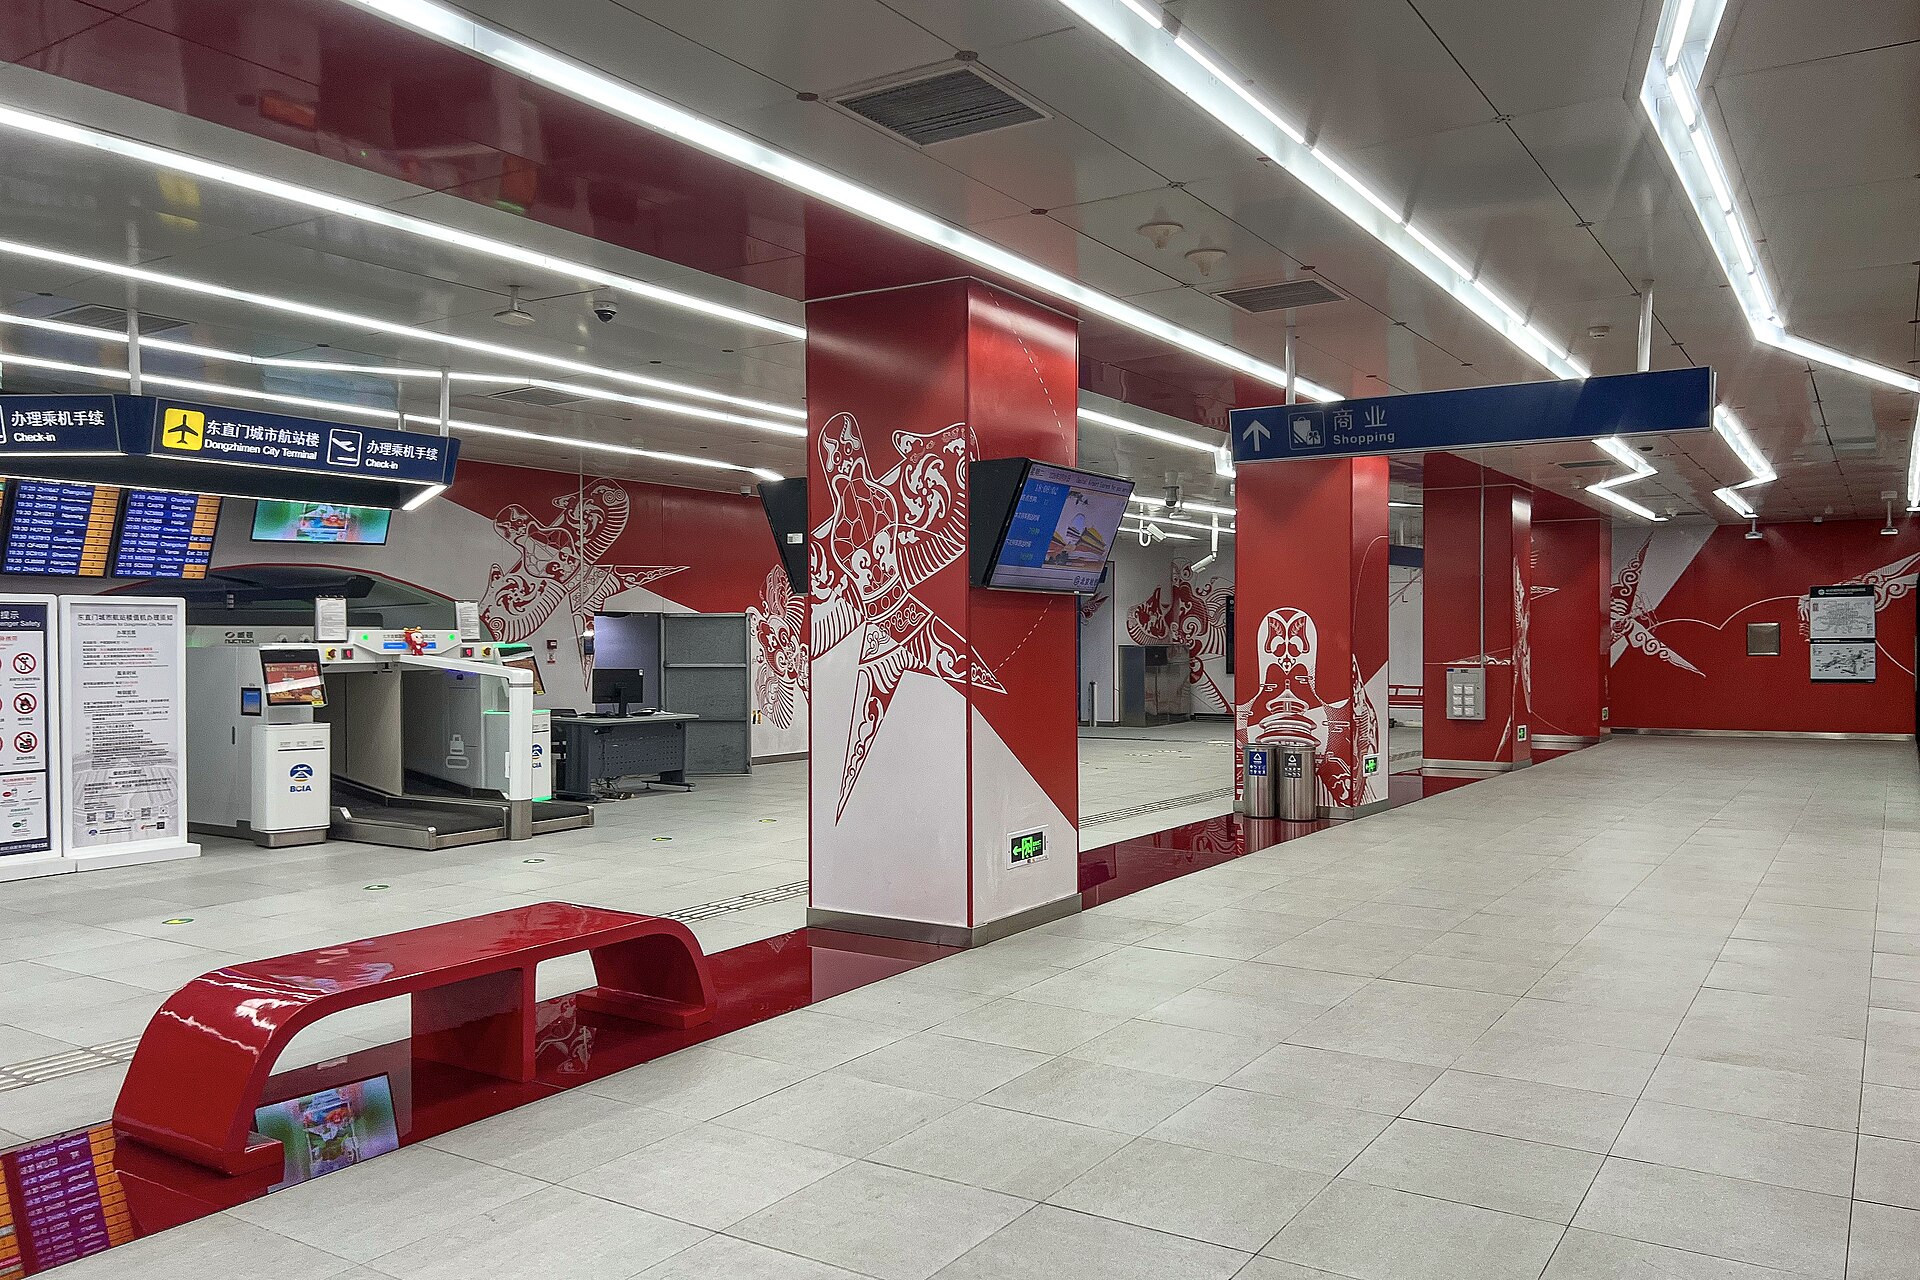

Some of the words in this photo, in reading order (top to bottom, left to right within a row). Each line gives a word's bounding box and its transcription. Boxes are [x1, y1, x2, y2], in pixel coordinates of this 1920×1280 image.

[11, 410, 105, 426] 办理乘机手续
[1333, 406, 1387, 431] 商业
[14, 433, 56, 441] Check-in
[206, 420, 319, 448] 东直门城市航站楼
[1333, 432, 1395, 445] Shopping
[204, 439, 260, 455] Dongzhimen
[263, 445, 279, 458] City
[282, 449, 317, 460] Terminal
[367, 440, 438, 461] 办理乘机手续
[366, 458, 398, 470] Check-in
